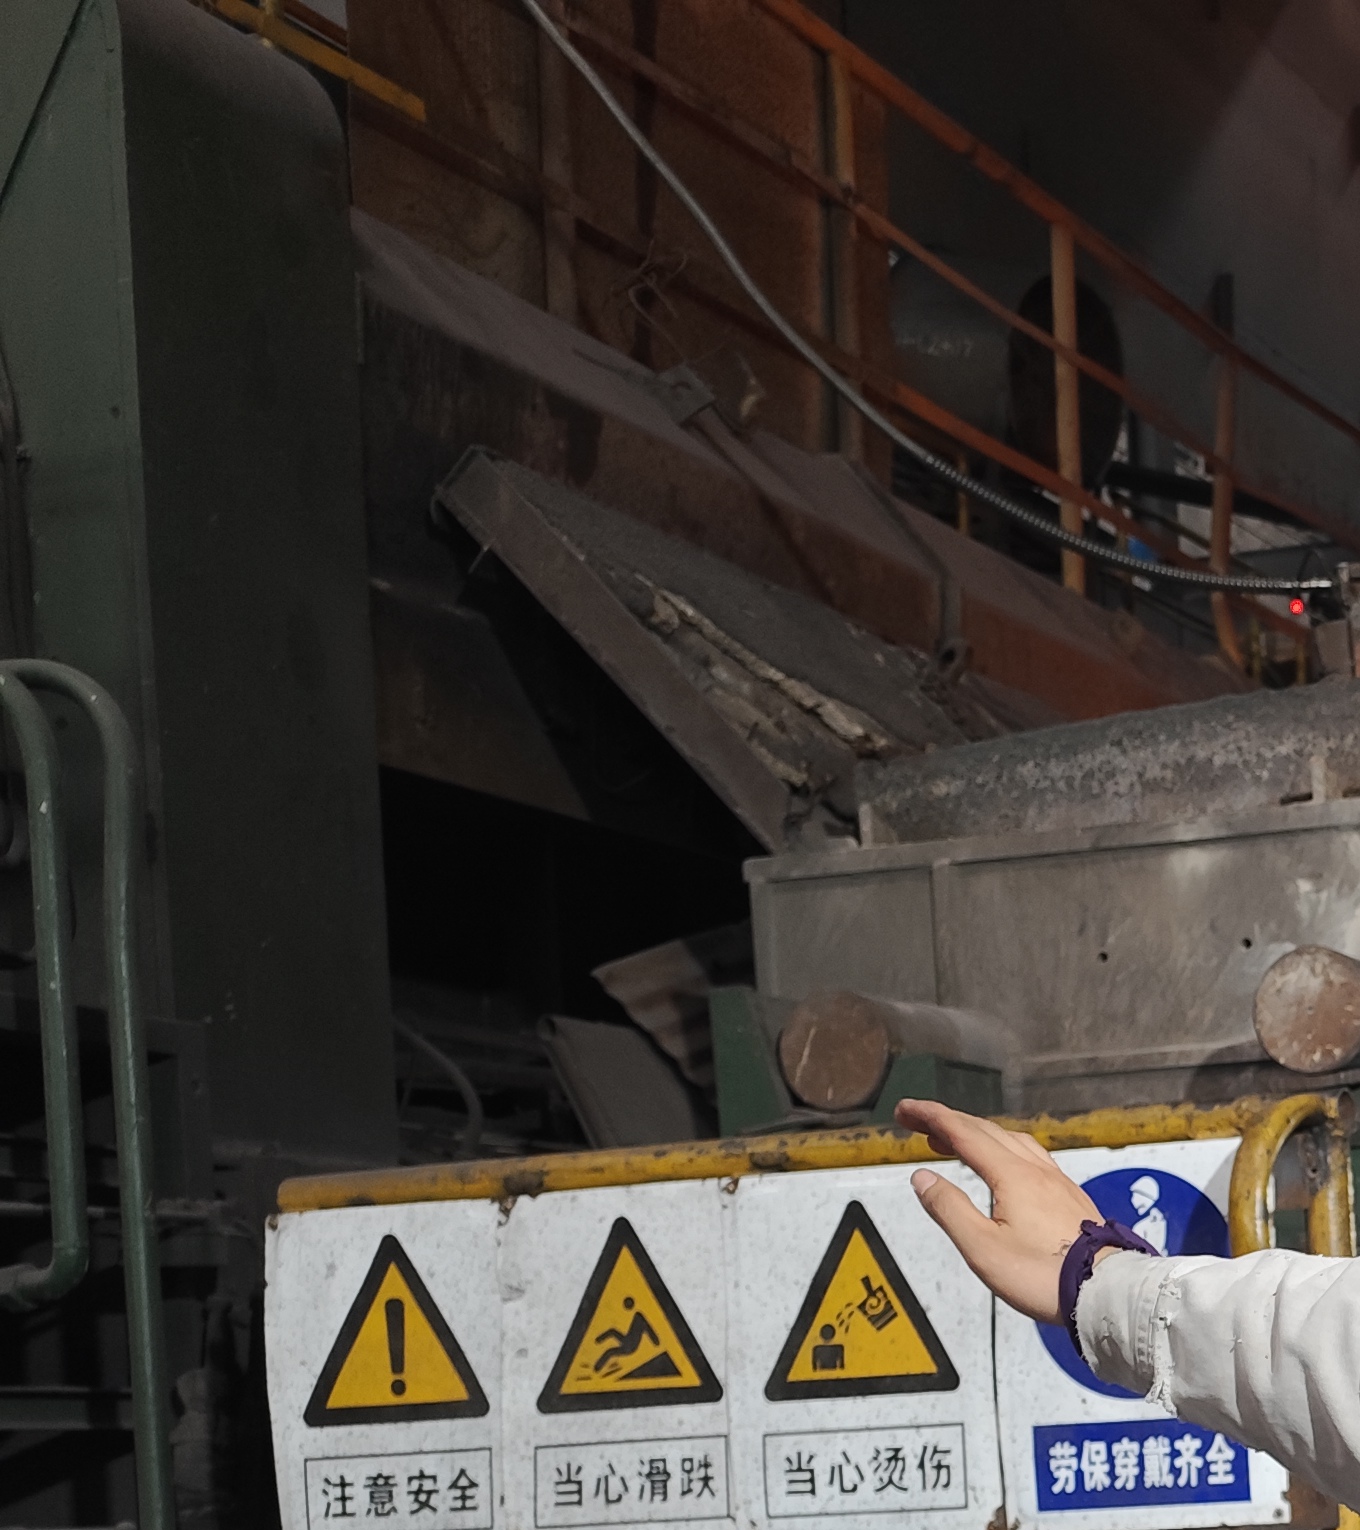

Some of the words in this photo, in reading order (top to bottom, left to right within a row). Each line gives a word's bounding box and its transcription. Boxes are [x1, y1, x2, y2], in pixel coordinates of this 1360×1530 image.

[553, 1454, 717, 1508] 当心滑跌
[783, 1443, 953, 1498] 当心烫伤
[1048, 1432, 1236, 1495] 劳保穿戴齐全
[321, 1467, 479, 1519] 注意安全
